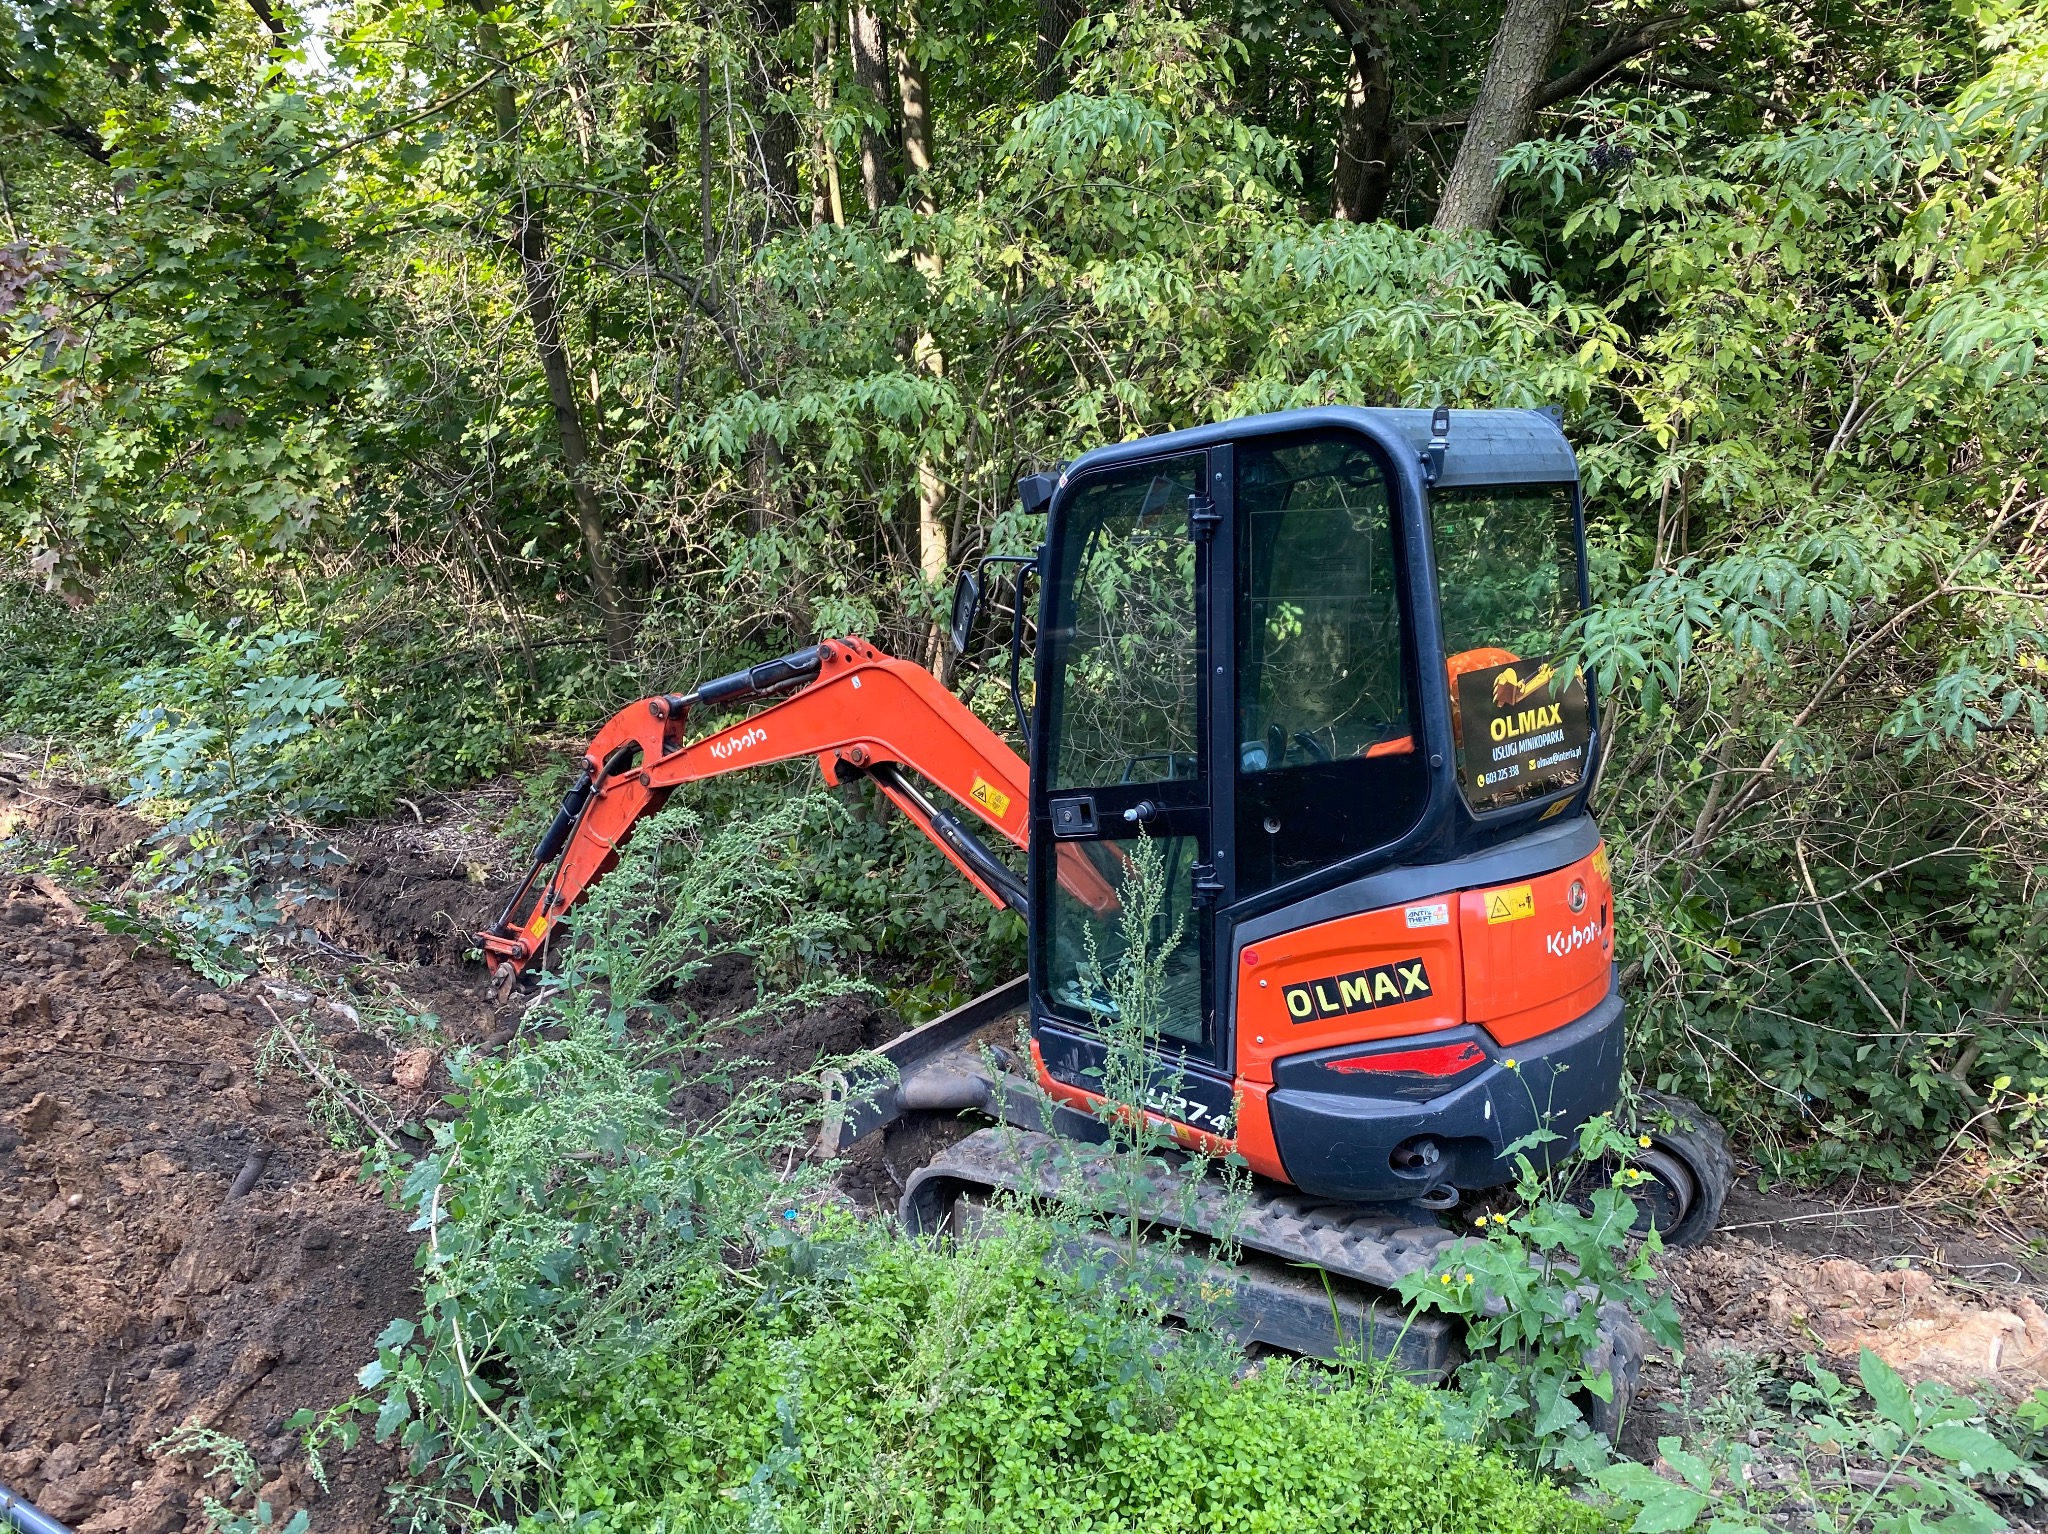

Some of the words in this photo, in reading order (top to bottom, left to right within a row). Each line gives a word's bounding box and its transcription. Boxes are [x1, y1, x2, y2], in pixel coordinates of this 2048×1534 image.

[1490, 702, 1562, 741] OLMAX
[710, 728, 768, 759] Kubota
[1519, 729, 1565, 754] MINIKOPARKA
[1485, 771, 1497, 785] 603
[1498, 767, 1508, 781] 225
[1509, 764, 1520, 778] 338
[1286, 963, 1430, 1017] OLMAX
